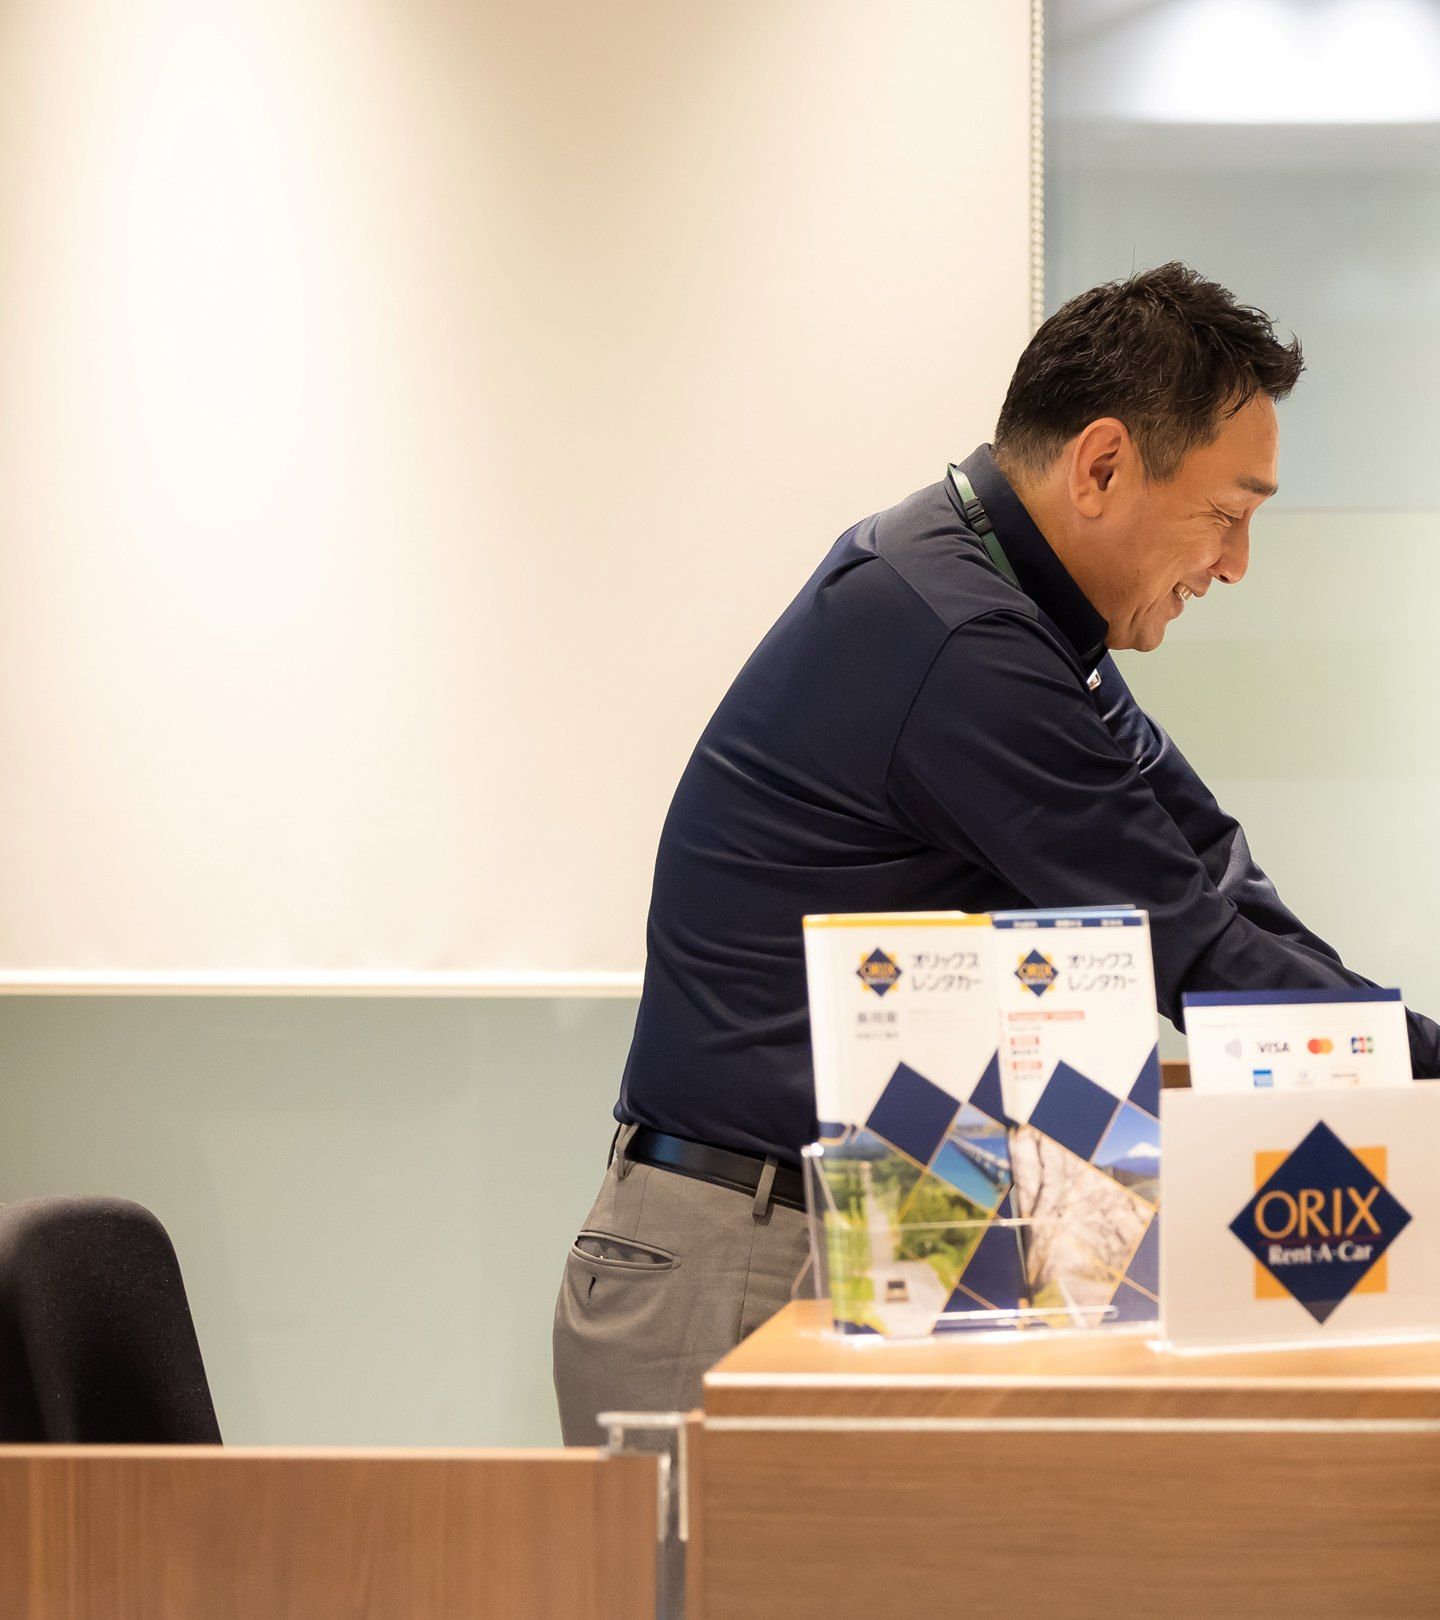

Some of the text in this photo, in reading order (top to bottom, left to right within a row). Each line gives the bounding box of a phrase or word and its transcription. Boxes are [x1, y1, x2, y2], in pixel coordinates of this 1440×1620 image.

[911, 952, 980, 970] オリックス
[1066, 952, 1135, 969] オリックス
[911, 974, 982, 992] レンタカー
[1067, 974, 1137, 992] レンタカー
[1257, 1041, 1290, 1053] VISA
[1254, 1186, 1382, 1240] ORIX
